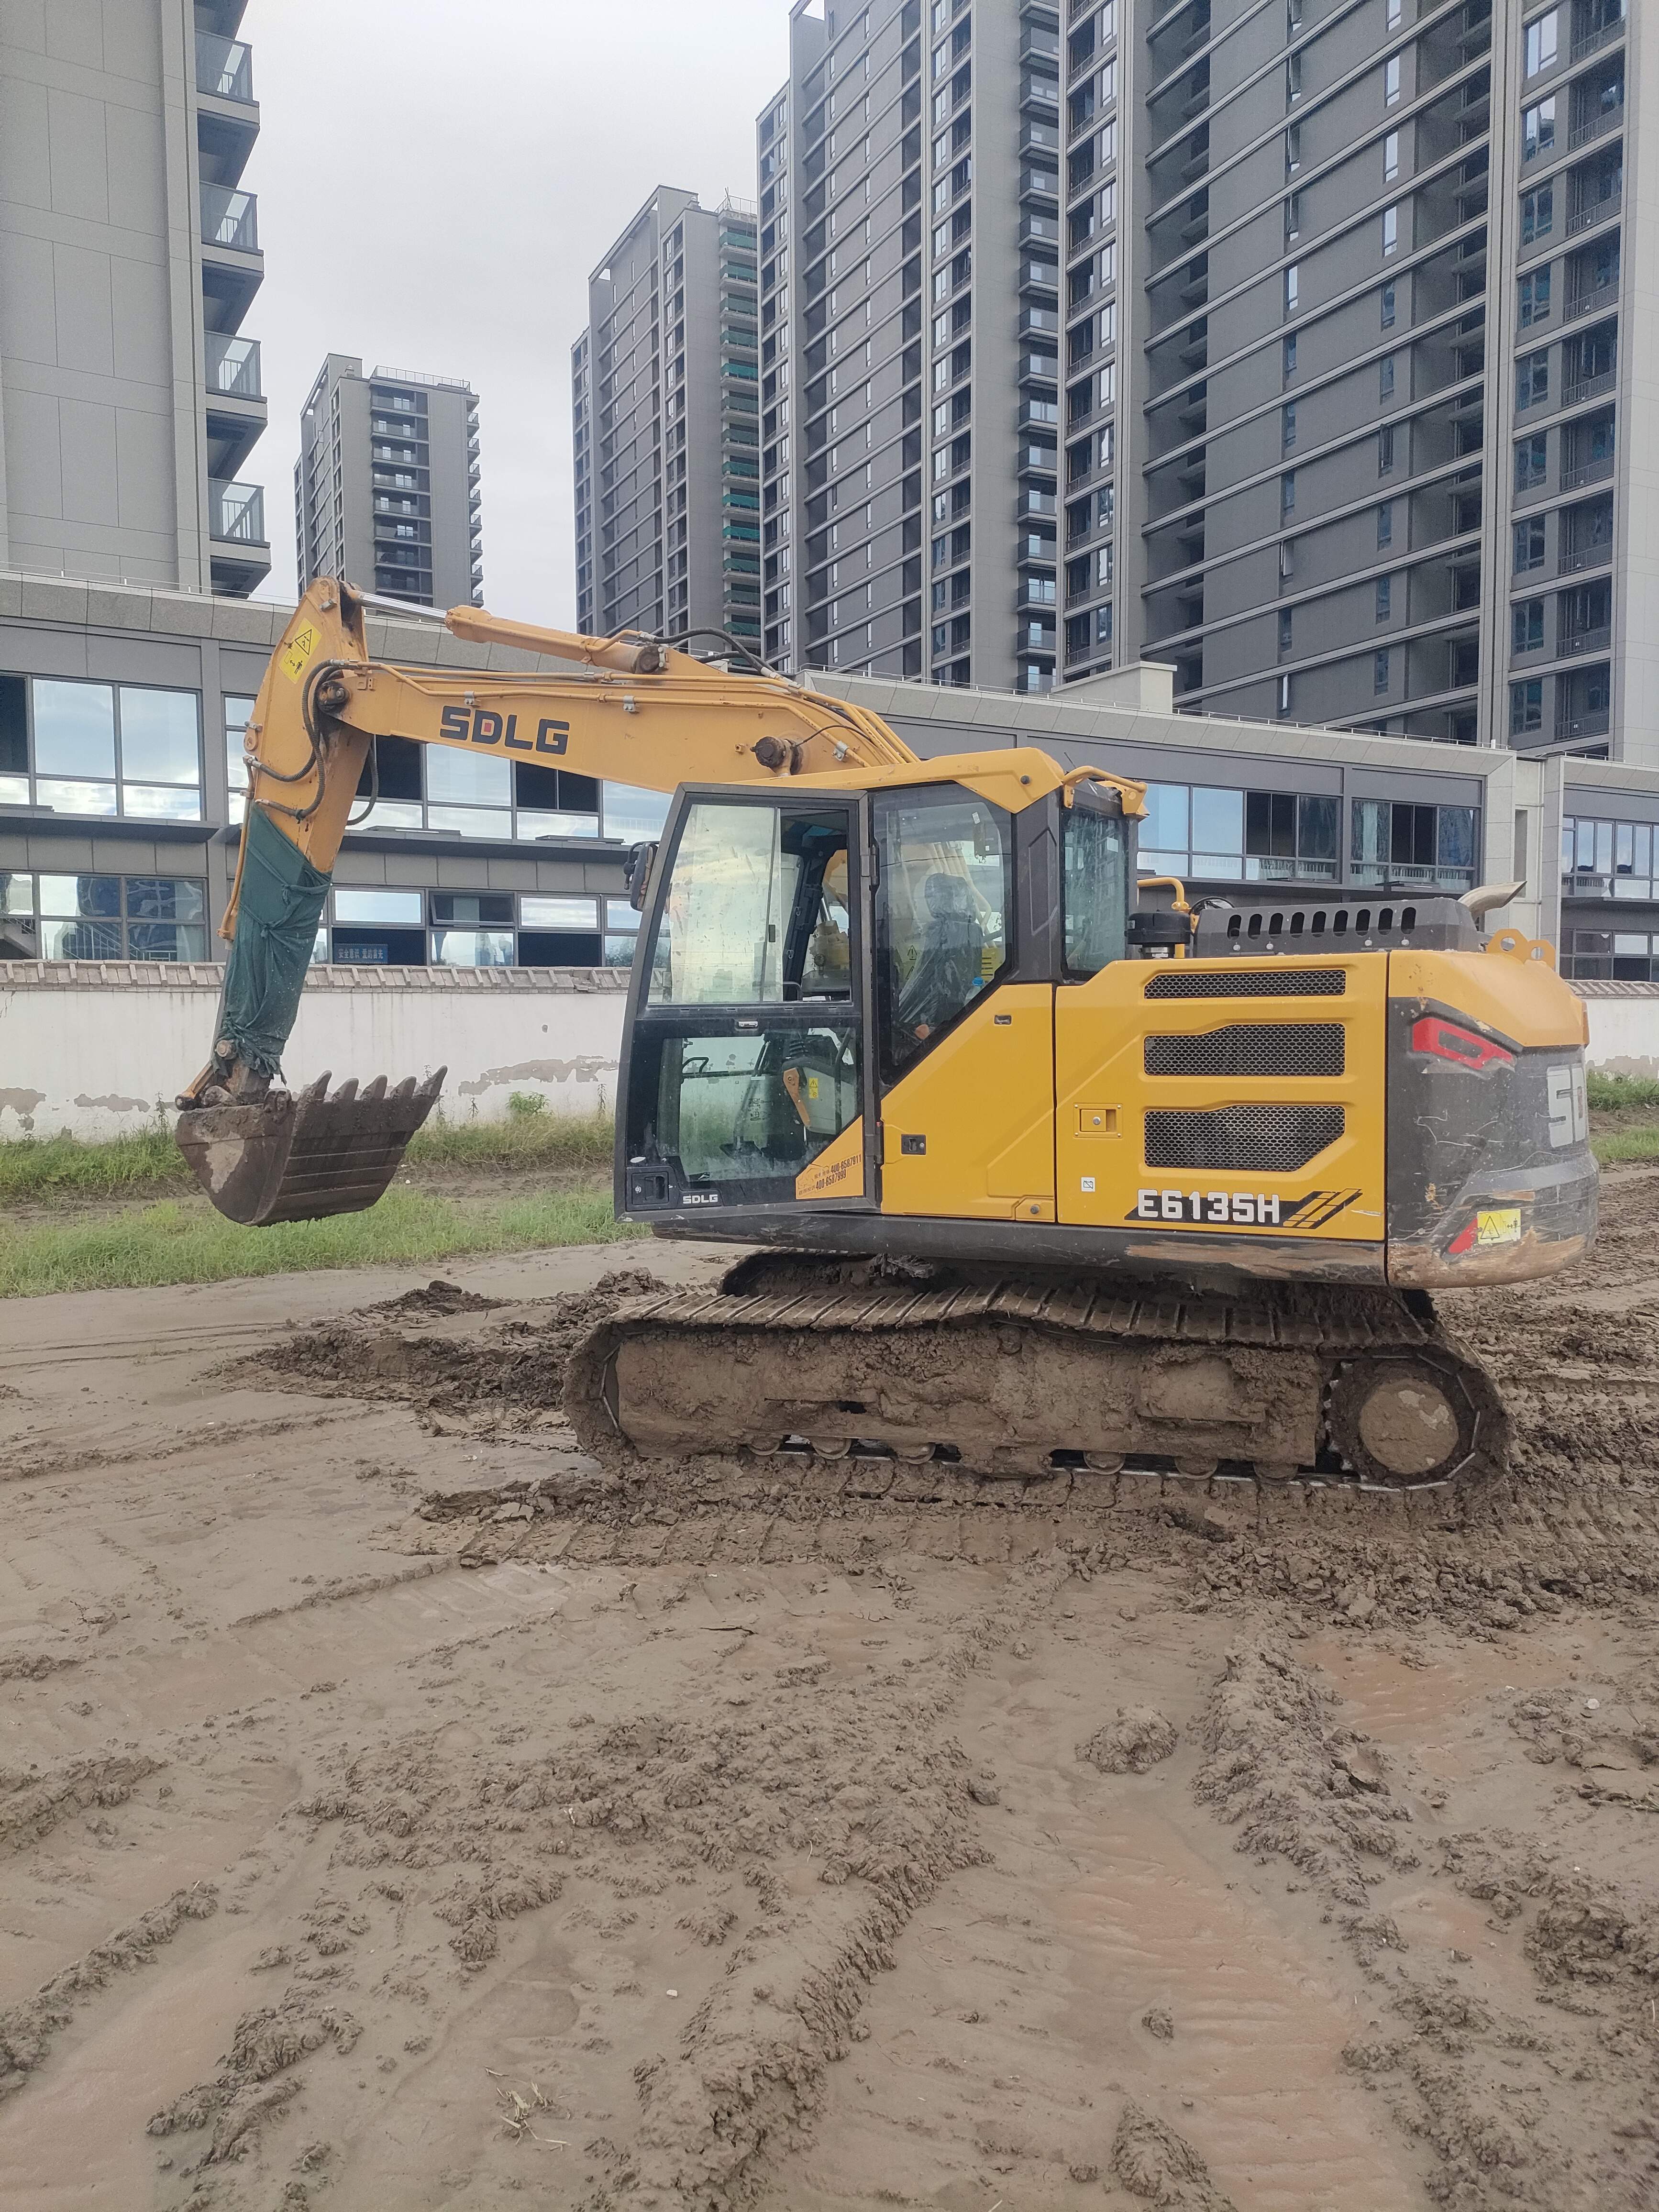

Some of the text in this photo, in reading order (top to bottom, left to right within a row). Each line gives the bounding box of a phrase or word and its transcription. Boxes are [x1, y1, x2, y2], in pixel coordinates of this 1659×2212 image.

[440, 705, 570, 755] SDLG
[683, 1194, 718, 1204] SDLG
[1138, 1189, 1280, 1223] E6135H
